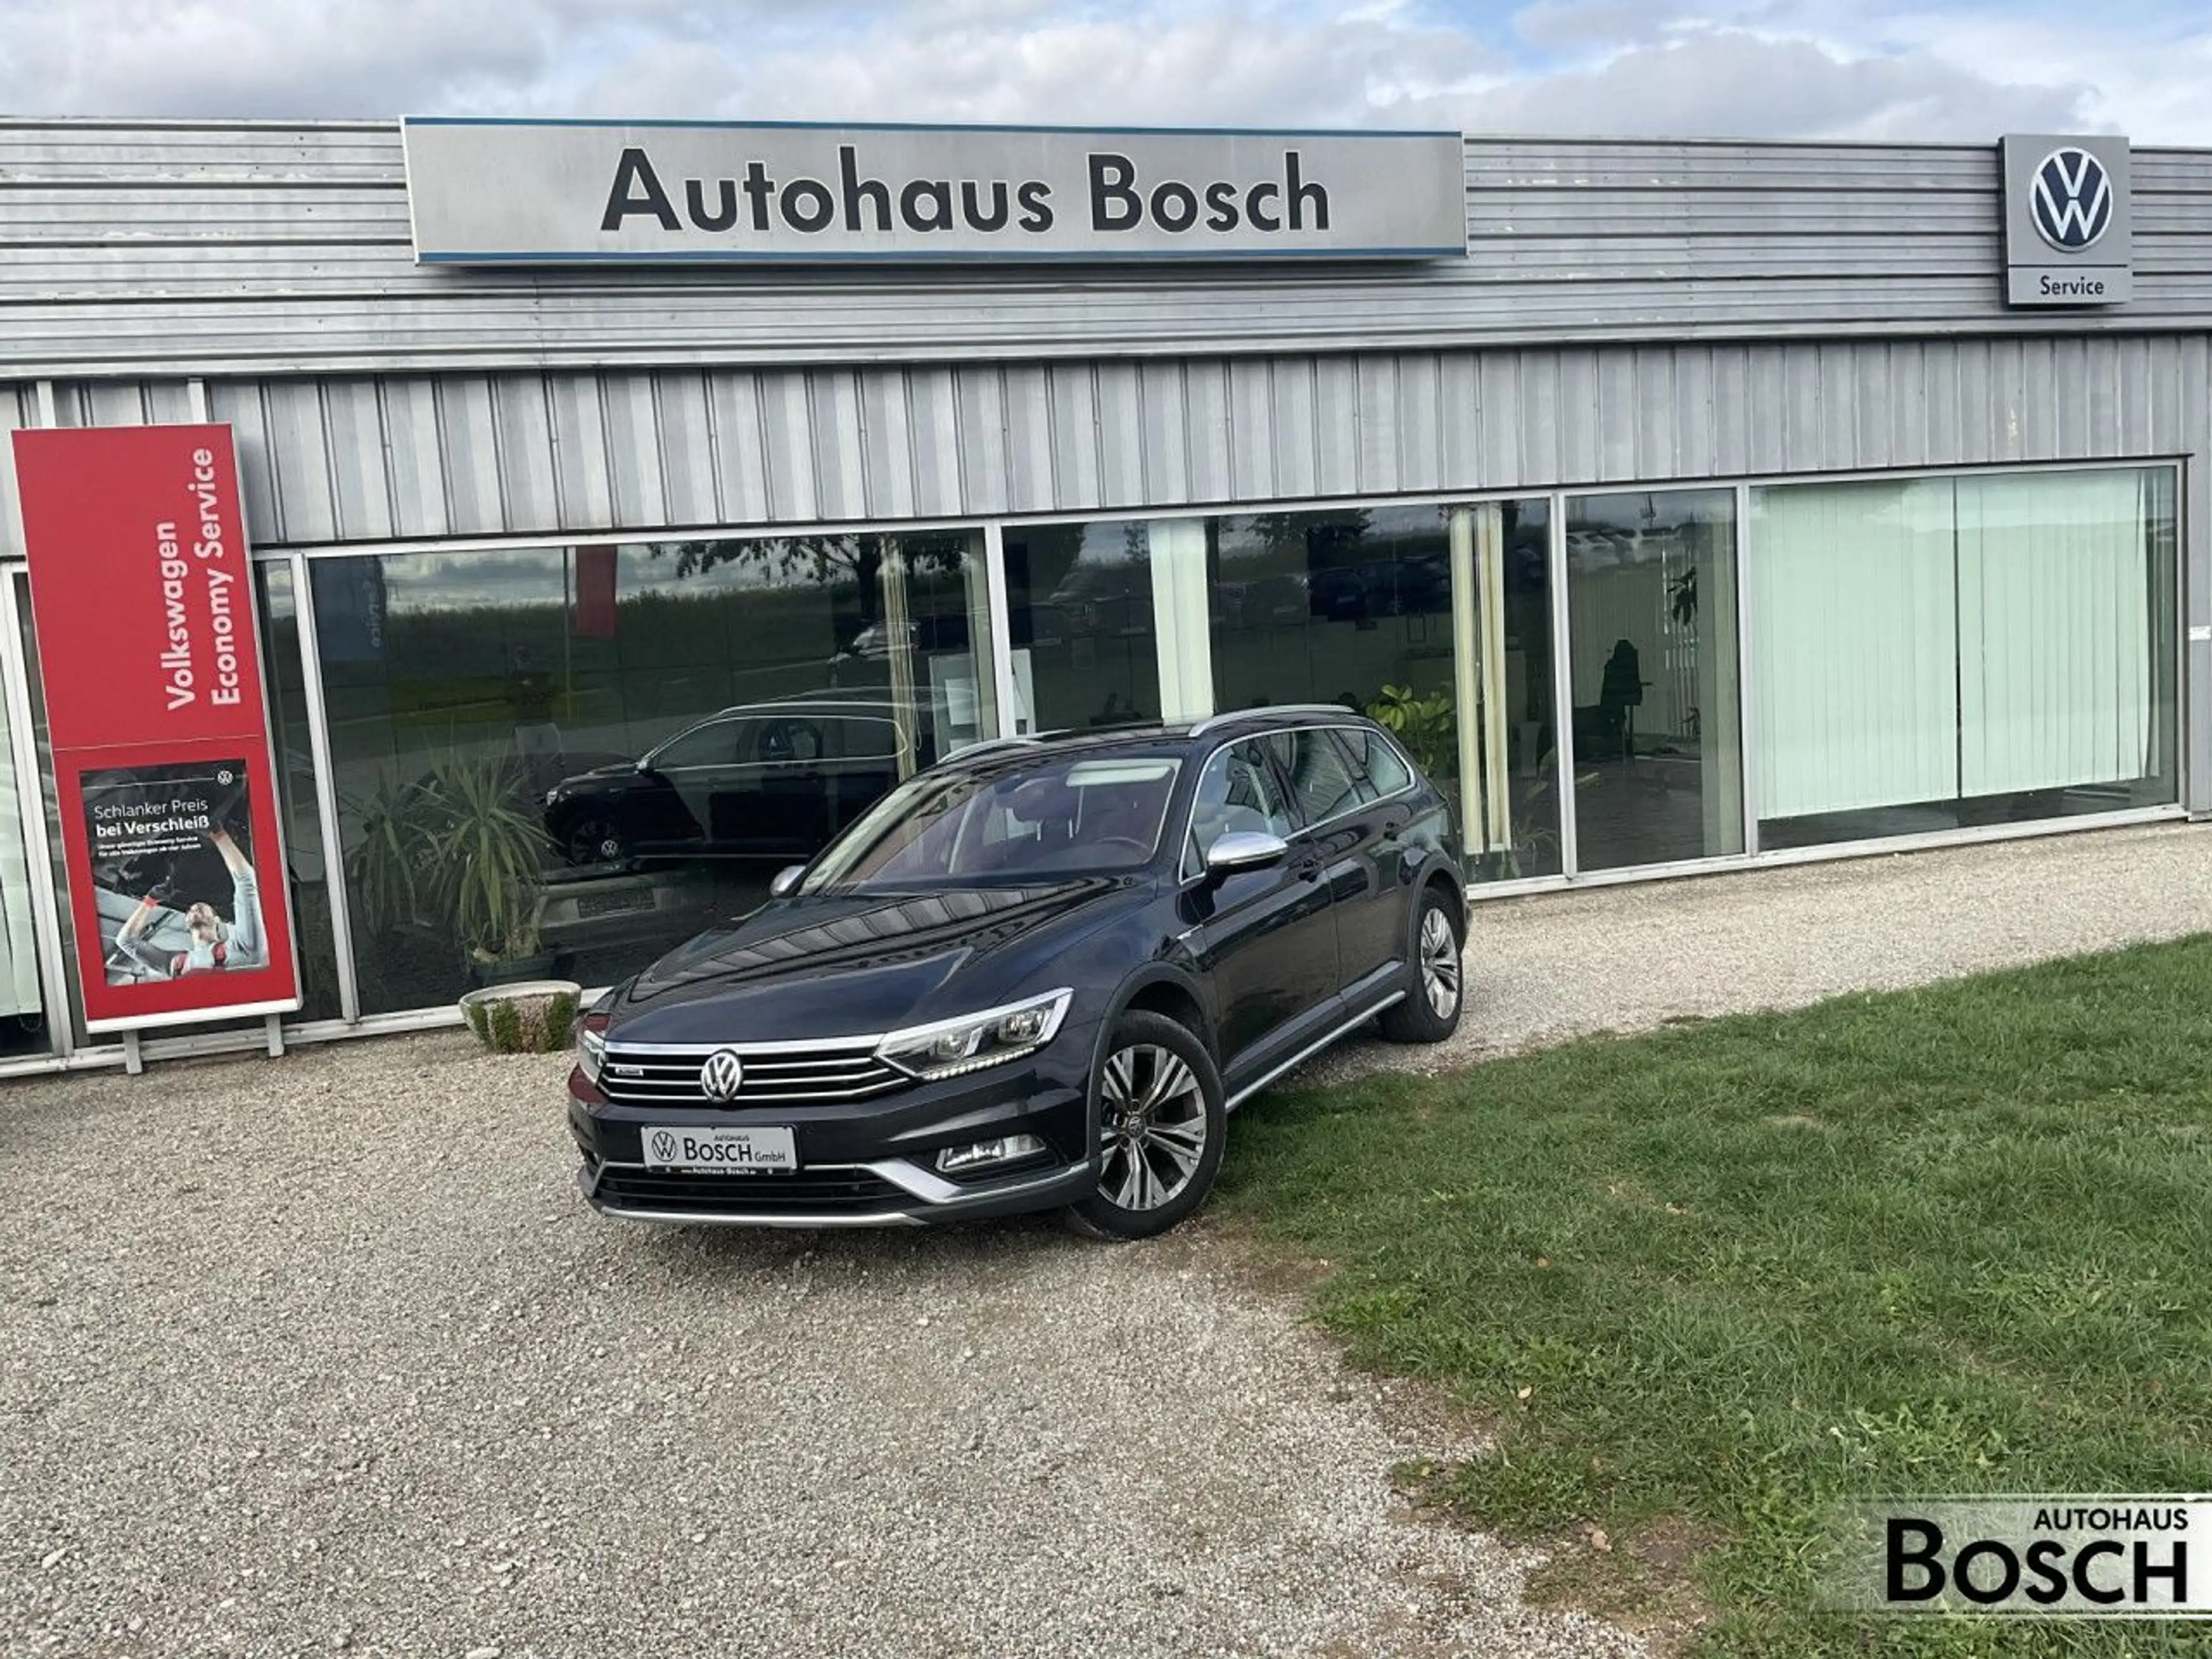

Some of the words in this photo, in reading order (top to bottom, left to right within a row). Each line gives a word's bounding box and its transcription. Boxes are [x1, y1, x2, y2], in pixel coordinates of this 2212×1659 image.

[601, 146, 1054, 232] Autohaus
[1089, 151, 1330, 232] Bosch
[2040, 275, 2104, 295] Service
[188, 448, 224, 559] Service
[156, 522, 196, 710] Volkswagen
[207, 568, 240, 705] Economy
[94, 801, 167, 819] Schlanker
[171, 798, 209, 813] Preis
[96, 822, 122, 838] bei
[124, 815, 210, 835] Verschleiß
[683, 1137, 752, 1162] BOSCH
[754, 1152, 786, 1162] GmbH
